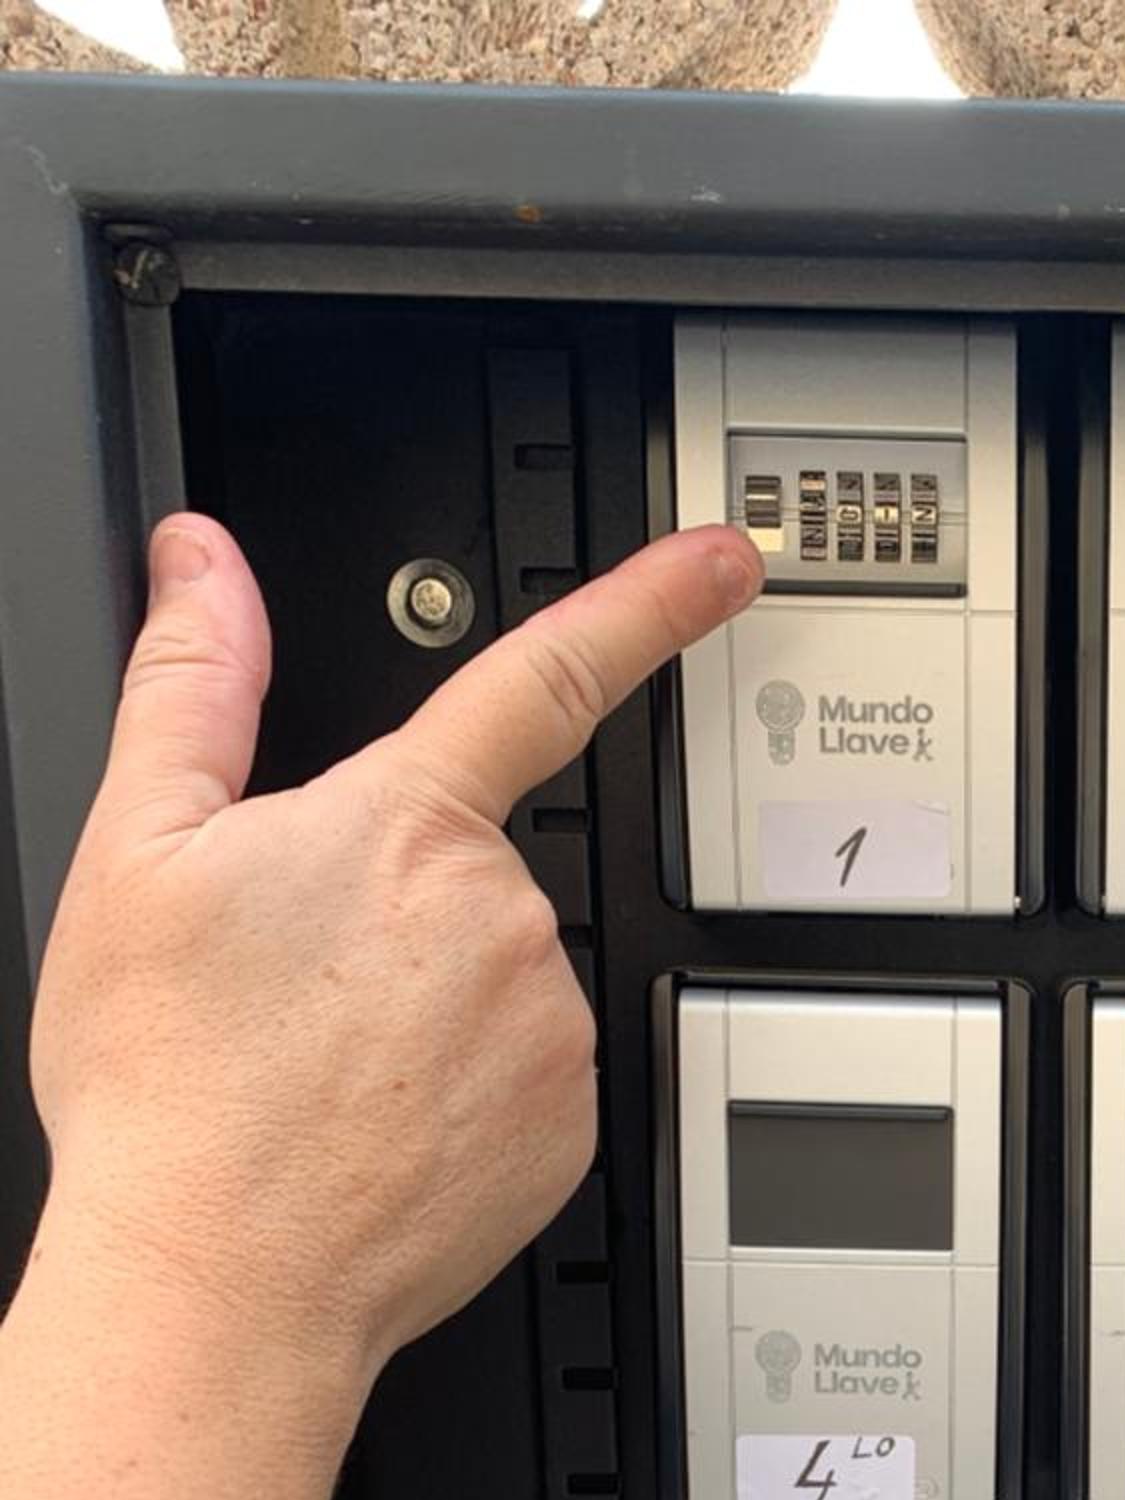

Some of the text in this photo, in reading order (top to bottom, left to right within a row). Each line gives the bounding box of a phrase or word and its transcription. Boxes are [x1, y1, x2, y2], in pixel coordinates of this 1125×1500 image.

[818, 693, 935, 725] Mundo
[818, 726, 910, 755] Llave
[834, 826, 868, 888] 1
[813, 1344, 923, 1368] Mundo
[813, 1371, 899, 1395] Llave
